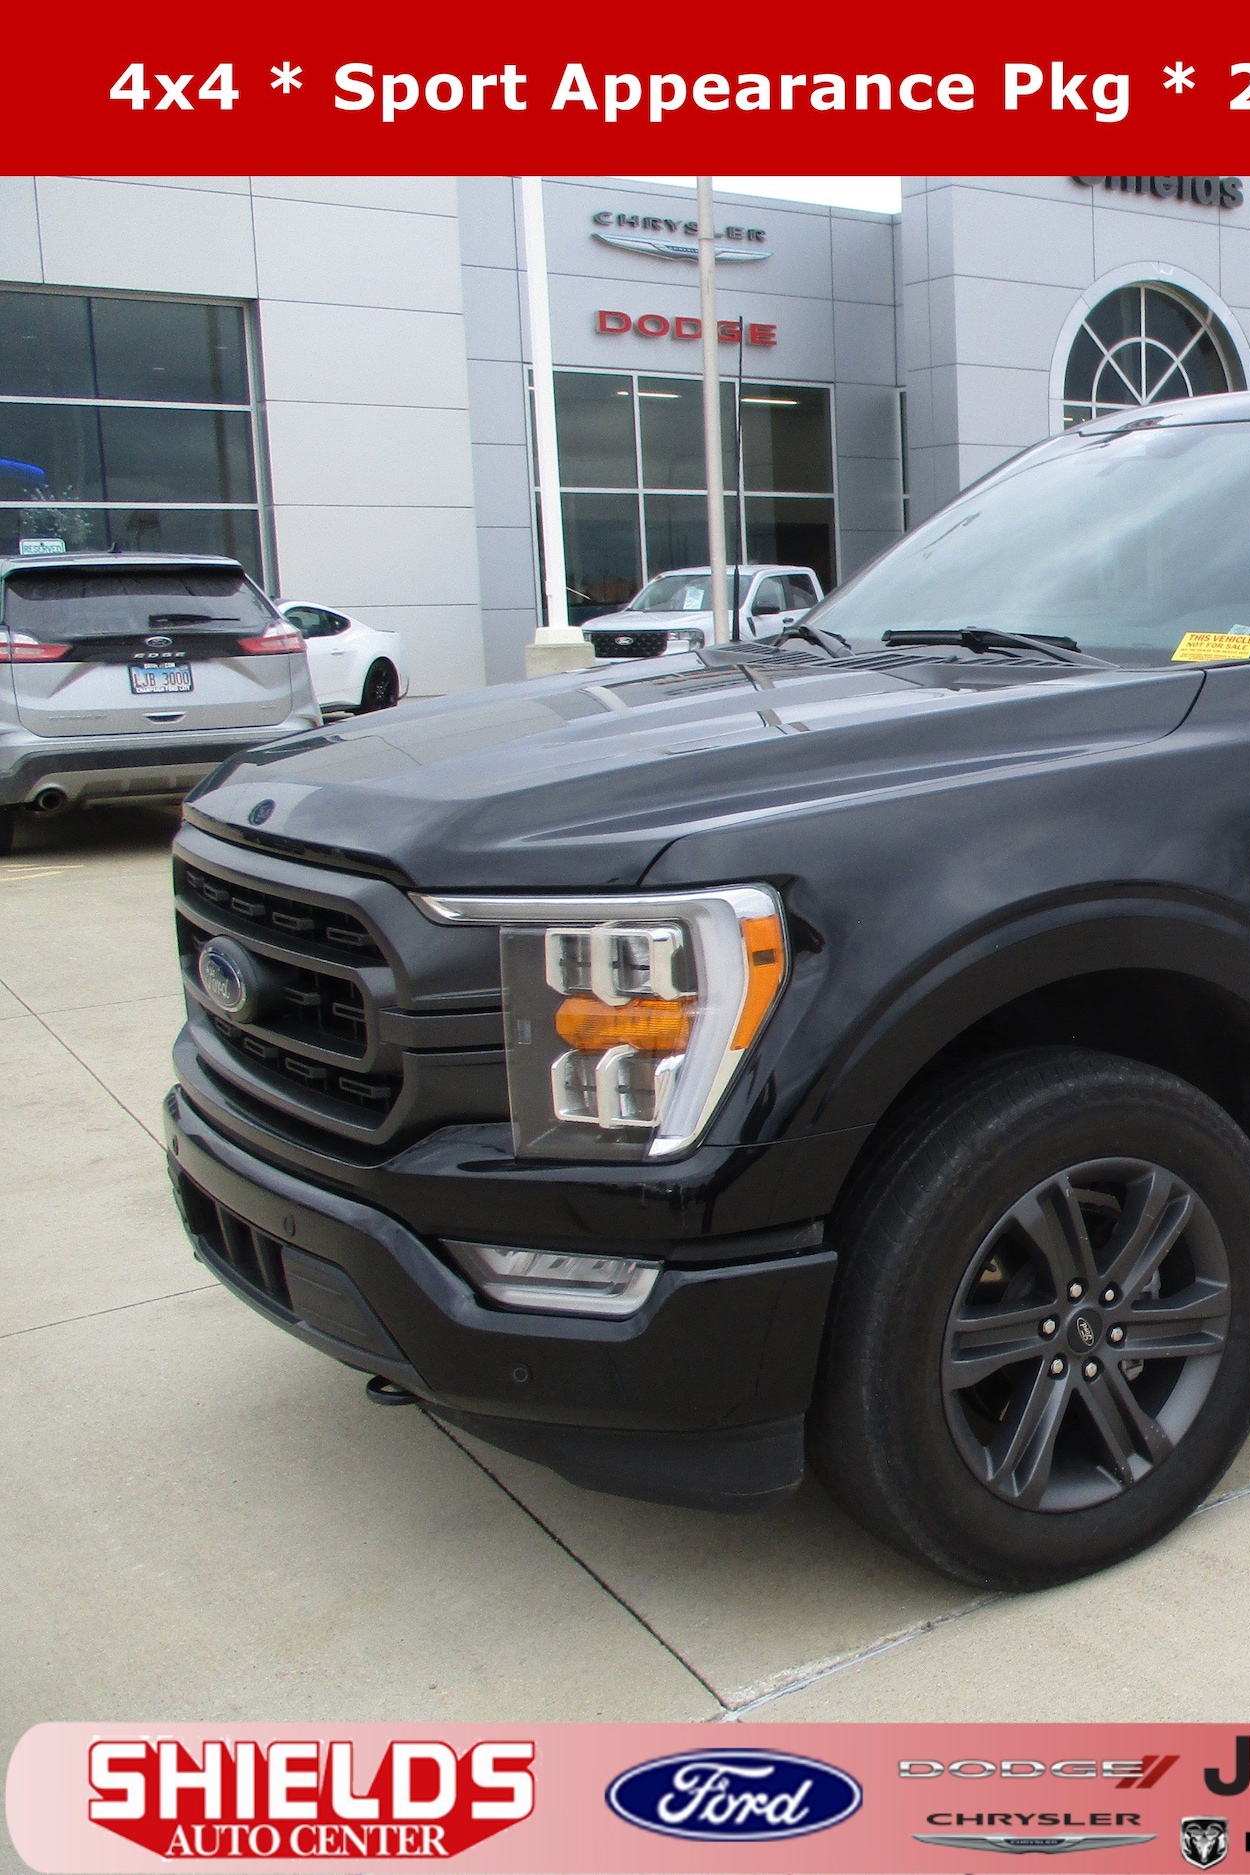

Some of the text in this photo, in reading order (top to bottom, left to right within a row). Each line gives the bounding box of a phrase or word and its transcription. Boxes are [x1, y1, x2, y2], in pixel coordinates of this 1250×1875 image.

[596, 310, 777, 347] DODGE
[24, 545, 63, 554] RESERVED
[1189, 634, 1211, 642] THIS
[1225, 643, 1249, 651] SALE
[134, 671, 190, 688] LJB 3000
